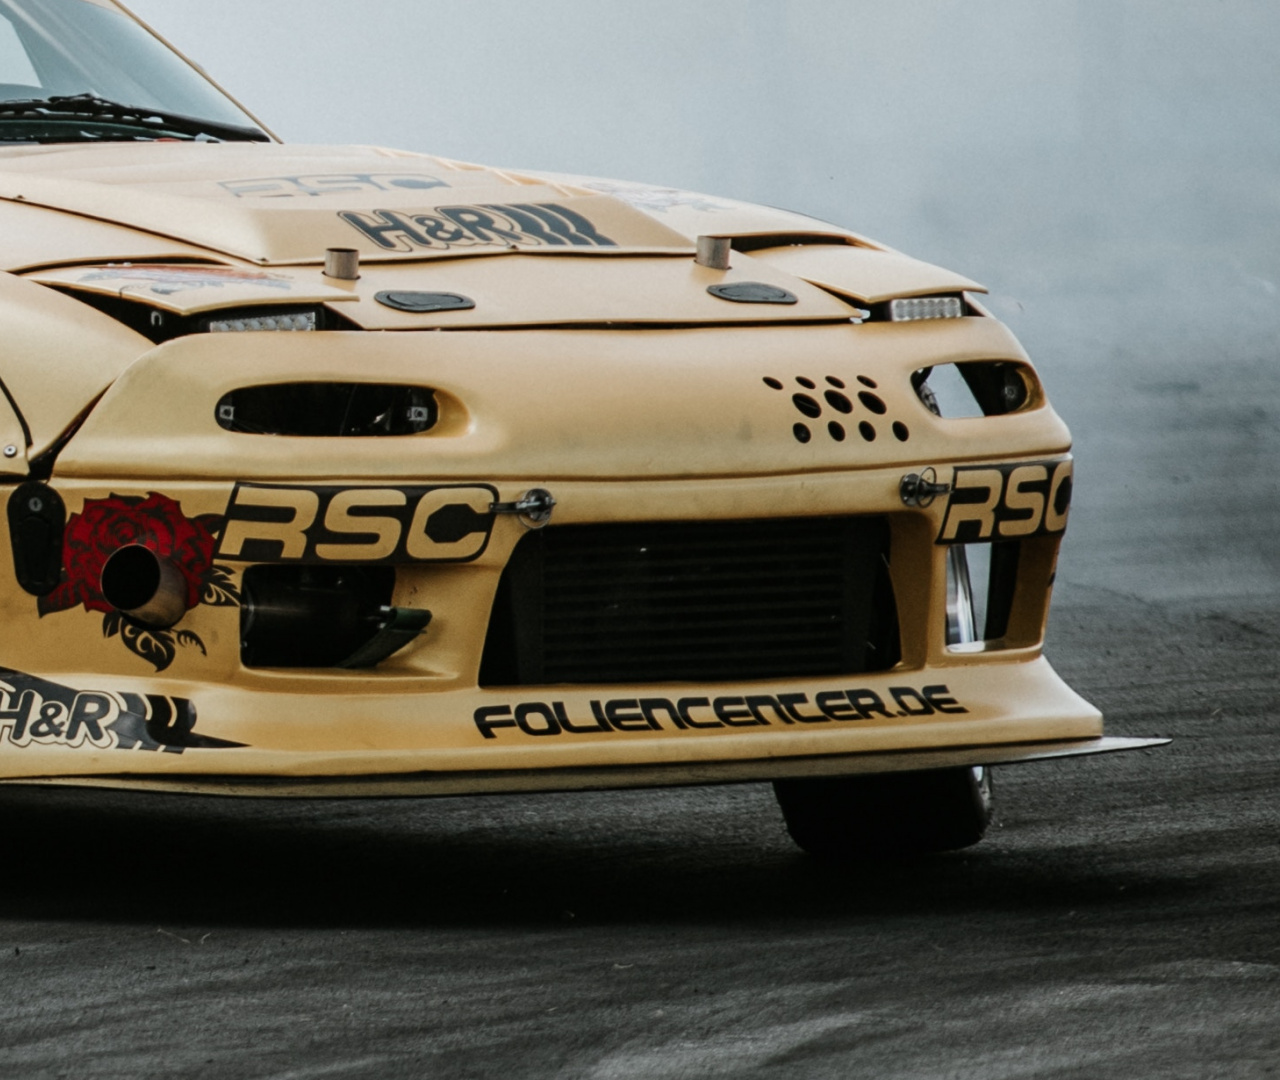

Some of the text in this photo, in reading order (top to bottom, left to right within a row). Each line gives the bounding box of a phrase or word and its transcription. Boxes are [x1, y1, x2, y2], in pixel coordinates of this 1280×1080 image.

[337, 204, 524, 252] H&R
[219, 487, 495, 561] RSC
[472, 684, 970, 740] FOLIENCENTER.DE
